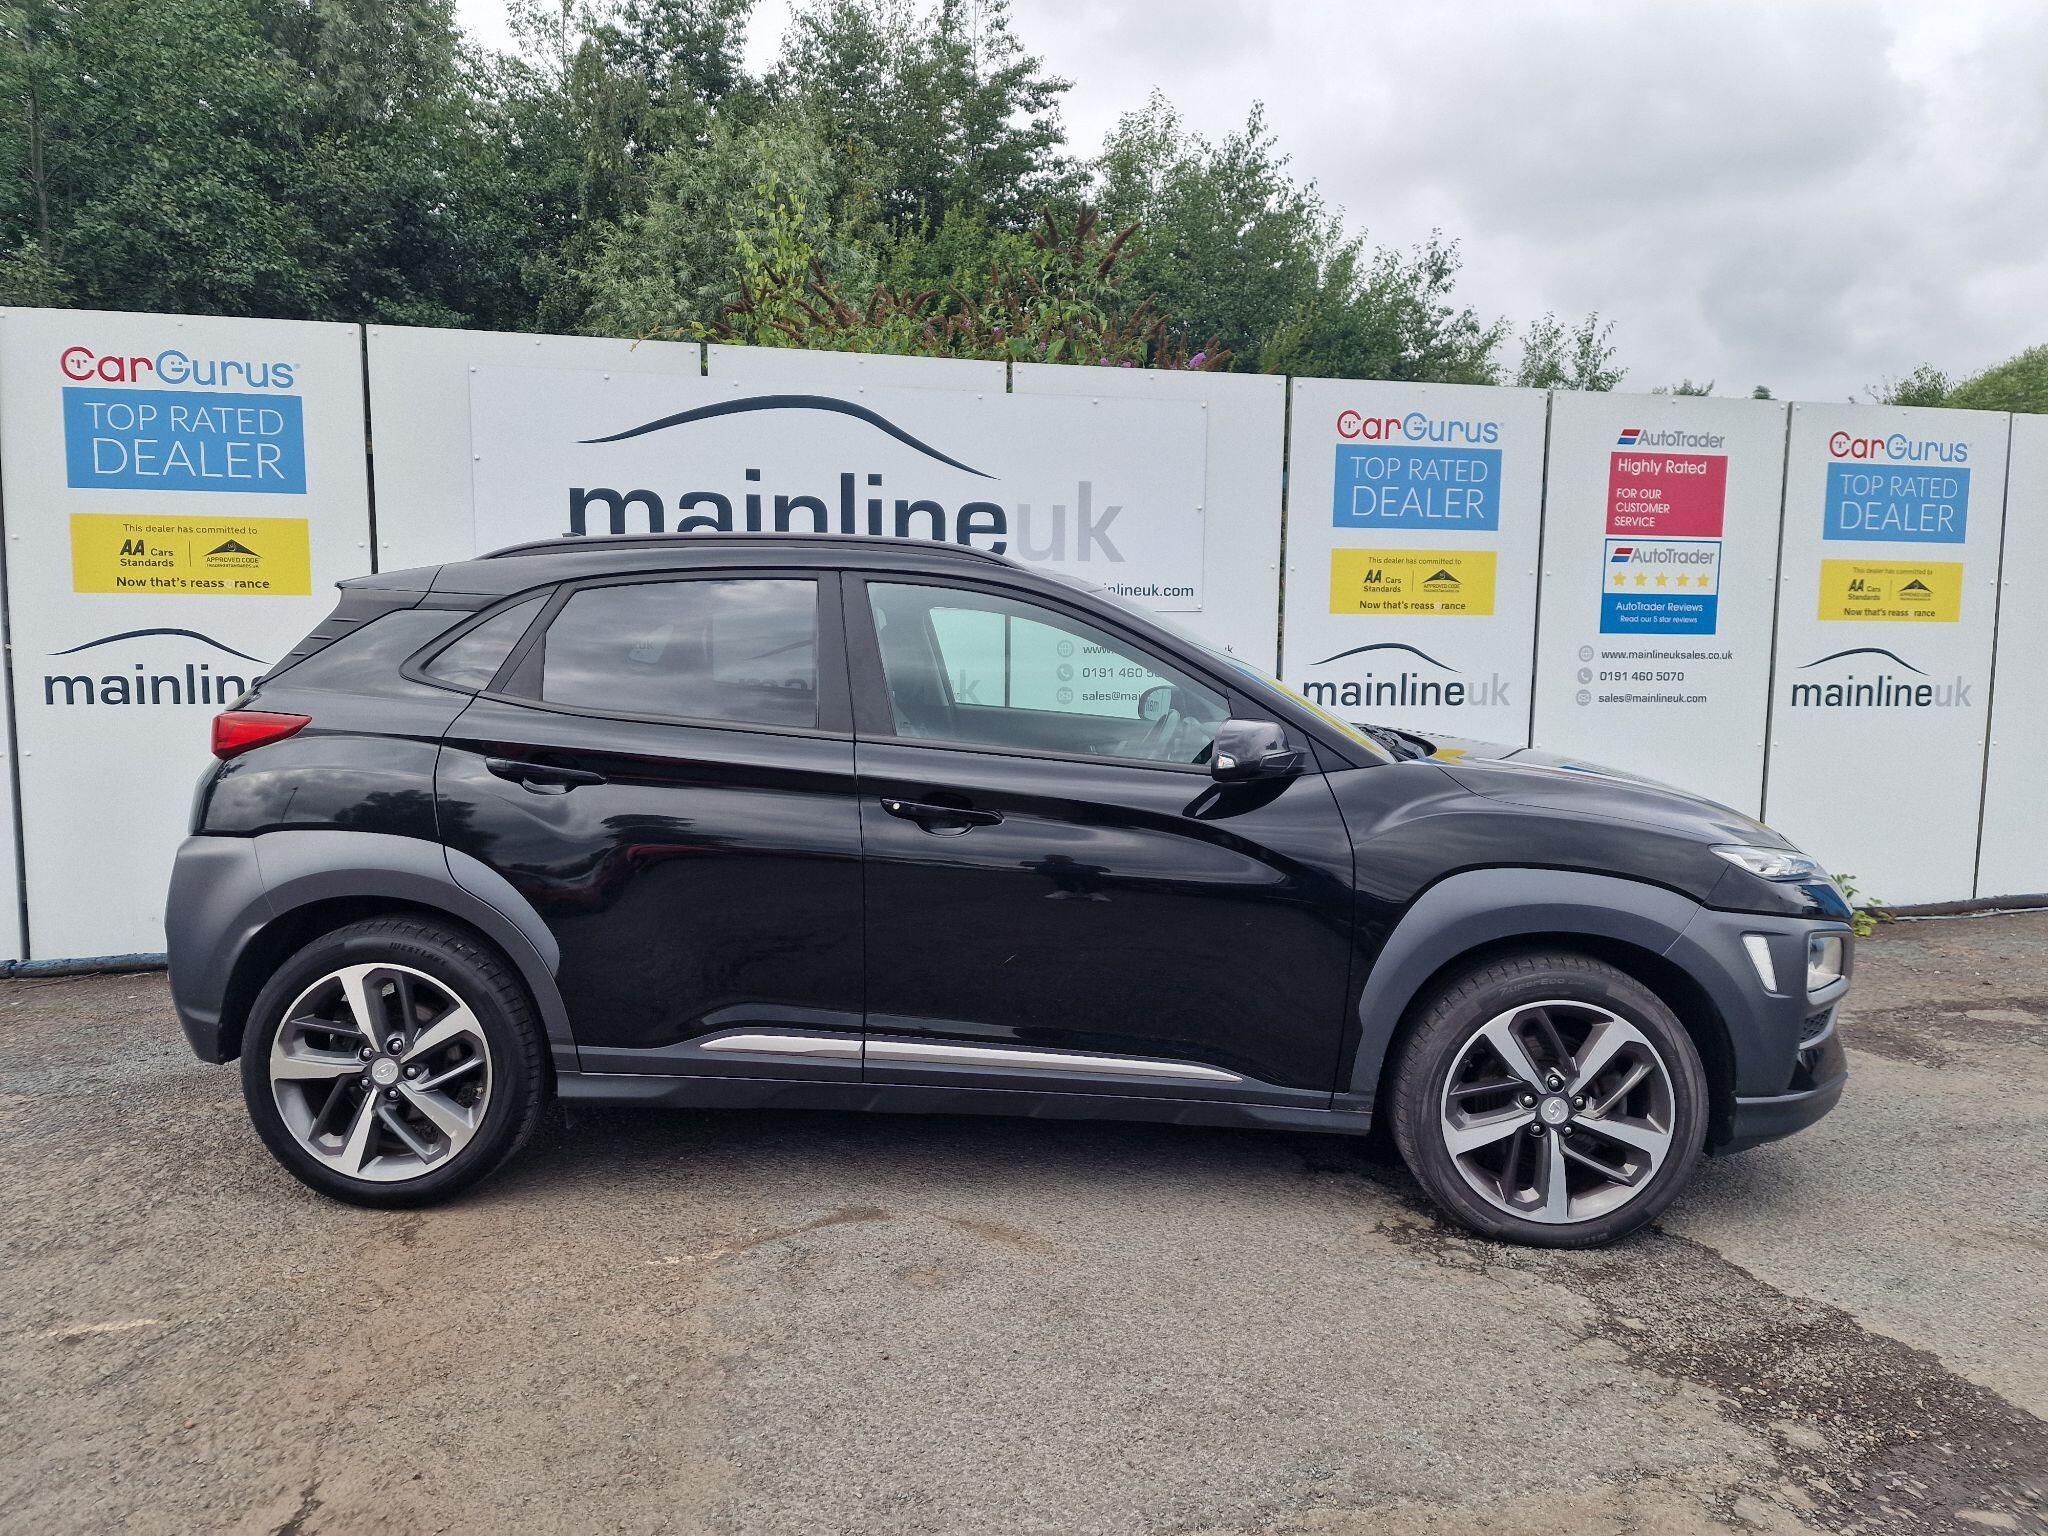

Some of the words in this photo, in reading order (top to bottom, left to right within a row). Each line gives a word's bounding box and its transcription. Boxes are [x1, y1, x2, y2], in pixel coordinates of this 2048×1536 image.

[60, 346, 295, 388] CarGurus
[84, 402, 157, 431] TOP
[170, 405, 284, 435] RATED
[1336, 410, 1499, 443] CarGurus
[1637, 429, 1725, 448] AutoTrader
[1829, 431, 1968, 463] CarGurus
[93, 437, 285, 480] DEALER
[1350, 456, 1401, 480] TOP
[1408, 459, 1488, 483] RATED
[1618, 458, 1662, 476] Highly
[1665, 460, 1708, 475] Rated
[1840, 474, 1883, 496] TOP
[1890, 476, 1958, 499] RATED
[1616, 488, 1637, 498] FOR
[1640, 489, 1662, 499] OUR
[1352, 485, 1485, 519] DEALER
[1616, 502, 1670, 514] CUSTOMER
[1614, 516, 1656, 527] SERVICE
[1840, 501, 1954, 532] DEALER
[123, 523, 143, 532] This
[145, 524, 175, 533] dealer
[178, 525, 193, 533] has
[195, 526, 246, 535] committed
[249, 527, 258, 535] to
[119, 539, 145, 556] AA
[150, 548, 174, 557] Cars
[1631, 548, 1715, 565] AutoTrader
[120, 559, 174, 568] Standards
[116, 576, 146, 587] Now
[150, 576, 187, 587] that's
[190, 579, 270, 589] reassrance
[1363, 569, 1382, 583] AA
[1363, 585, 1402, 593] Standards
[1848, 579, 1864, 592] AA
[1360, 601, 1380, 609] Now
[1383, 601, 1408, 609] that's
[1411, 602, 1466, 610] reassrance
[1616, 602, 1665, 612] AutoTrader
[1667, 603, 1703, 612] Reviews
[1844, 608, 1863, 616] Now
[1620, 615, 1640, 623] Read
[1653, 615, 1658, 623] 5
[1659, 615, 1671, 623] star
[1672, 616, 1698, 624] reviews
[1601, 649, 1733, 661] www.mainlineuksales.co.uk
[1082, 667, 1114, 678] 0191
[1118, 667, 1143, 678] 460
[1599, 671, 1628, 681] 0191
[1631, 671, 1653, 682] 460
[1656, 671, 1684, 682] 5070
[44, 664, 266, 705] mainlin
[1598, 693, 1707, 703] sales@mainlineuk.com
